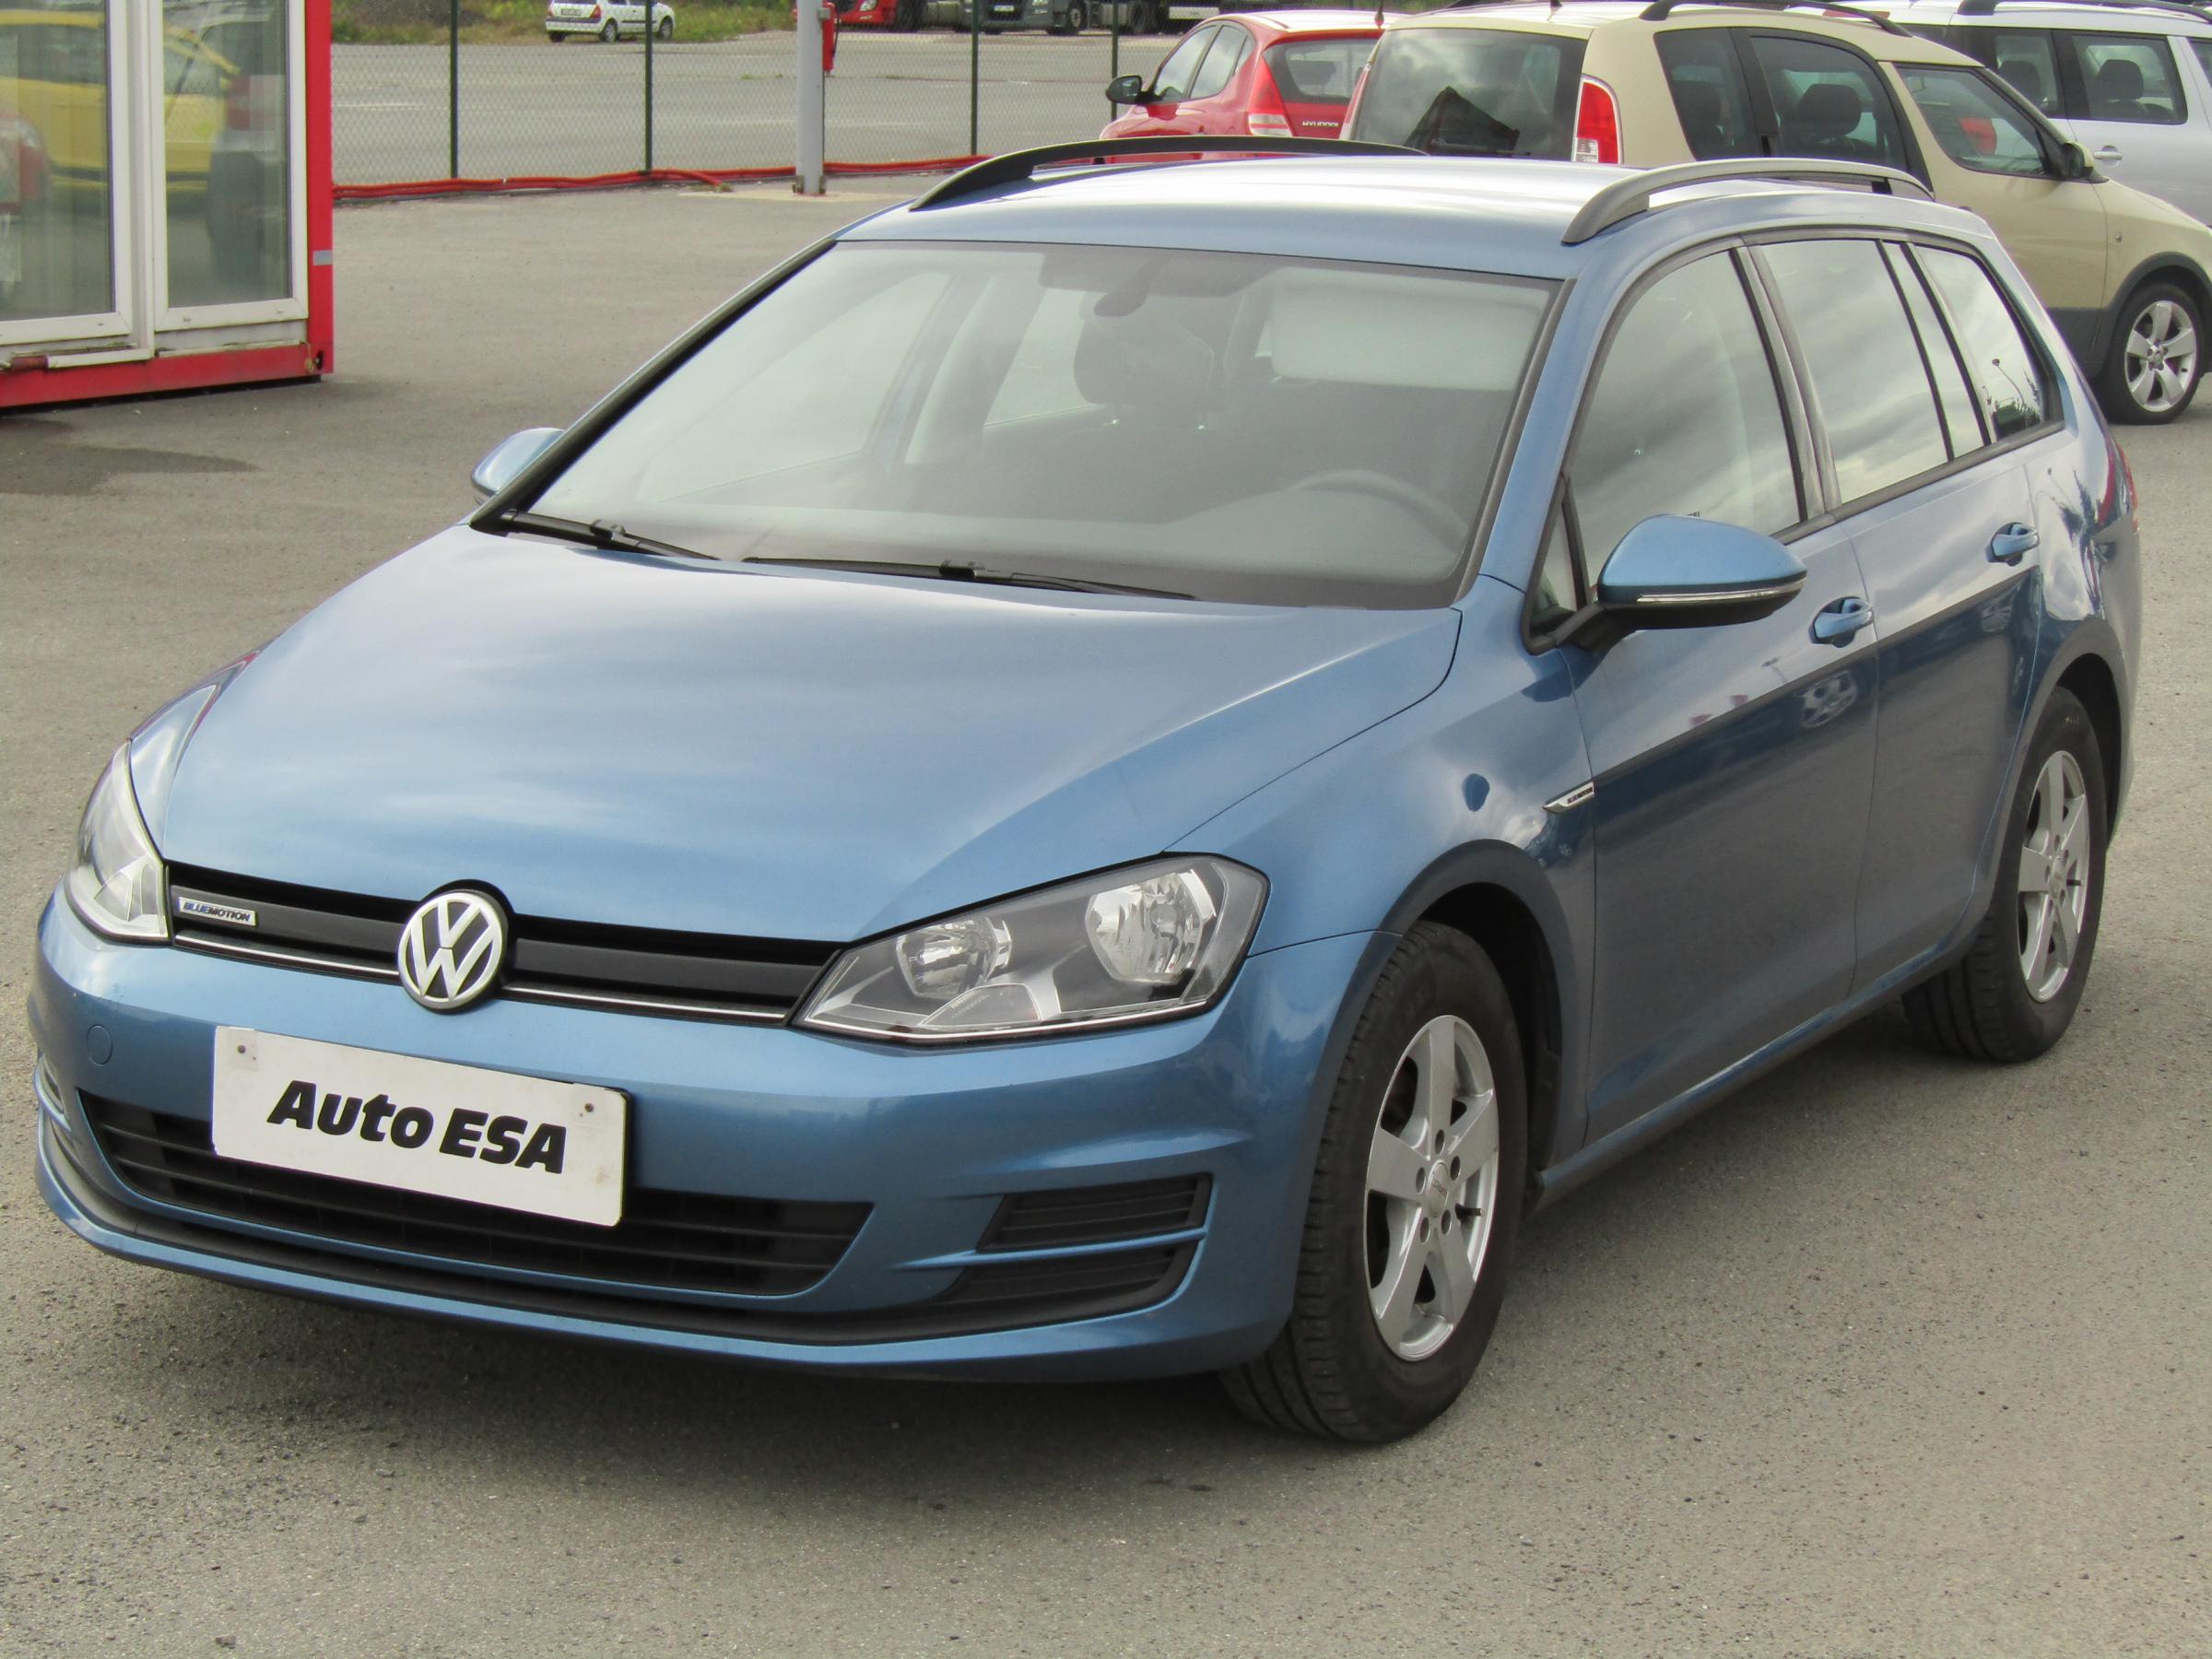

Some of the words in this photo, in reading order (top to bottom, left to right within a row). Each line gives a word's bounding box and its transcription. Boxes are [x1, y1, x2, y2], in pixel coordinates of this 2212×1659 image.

[182, 901, 252, 922] BLUEMOTION
[403, 893, 500, 1005] VW
[266, 1080, 434, 1149] Auto
[439, 1107, 567, 1174] ESA
